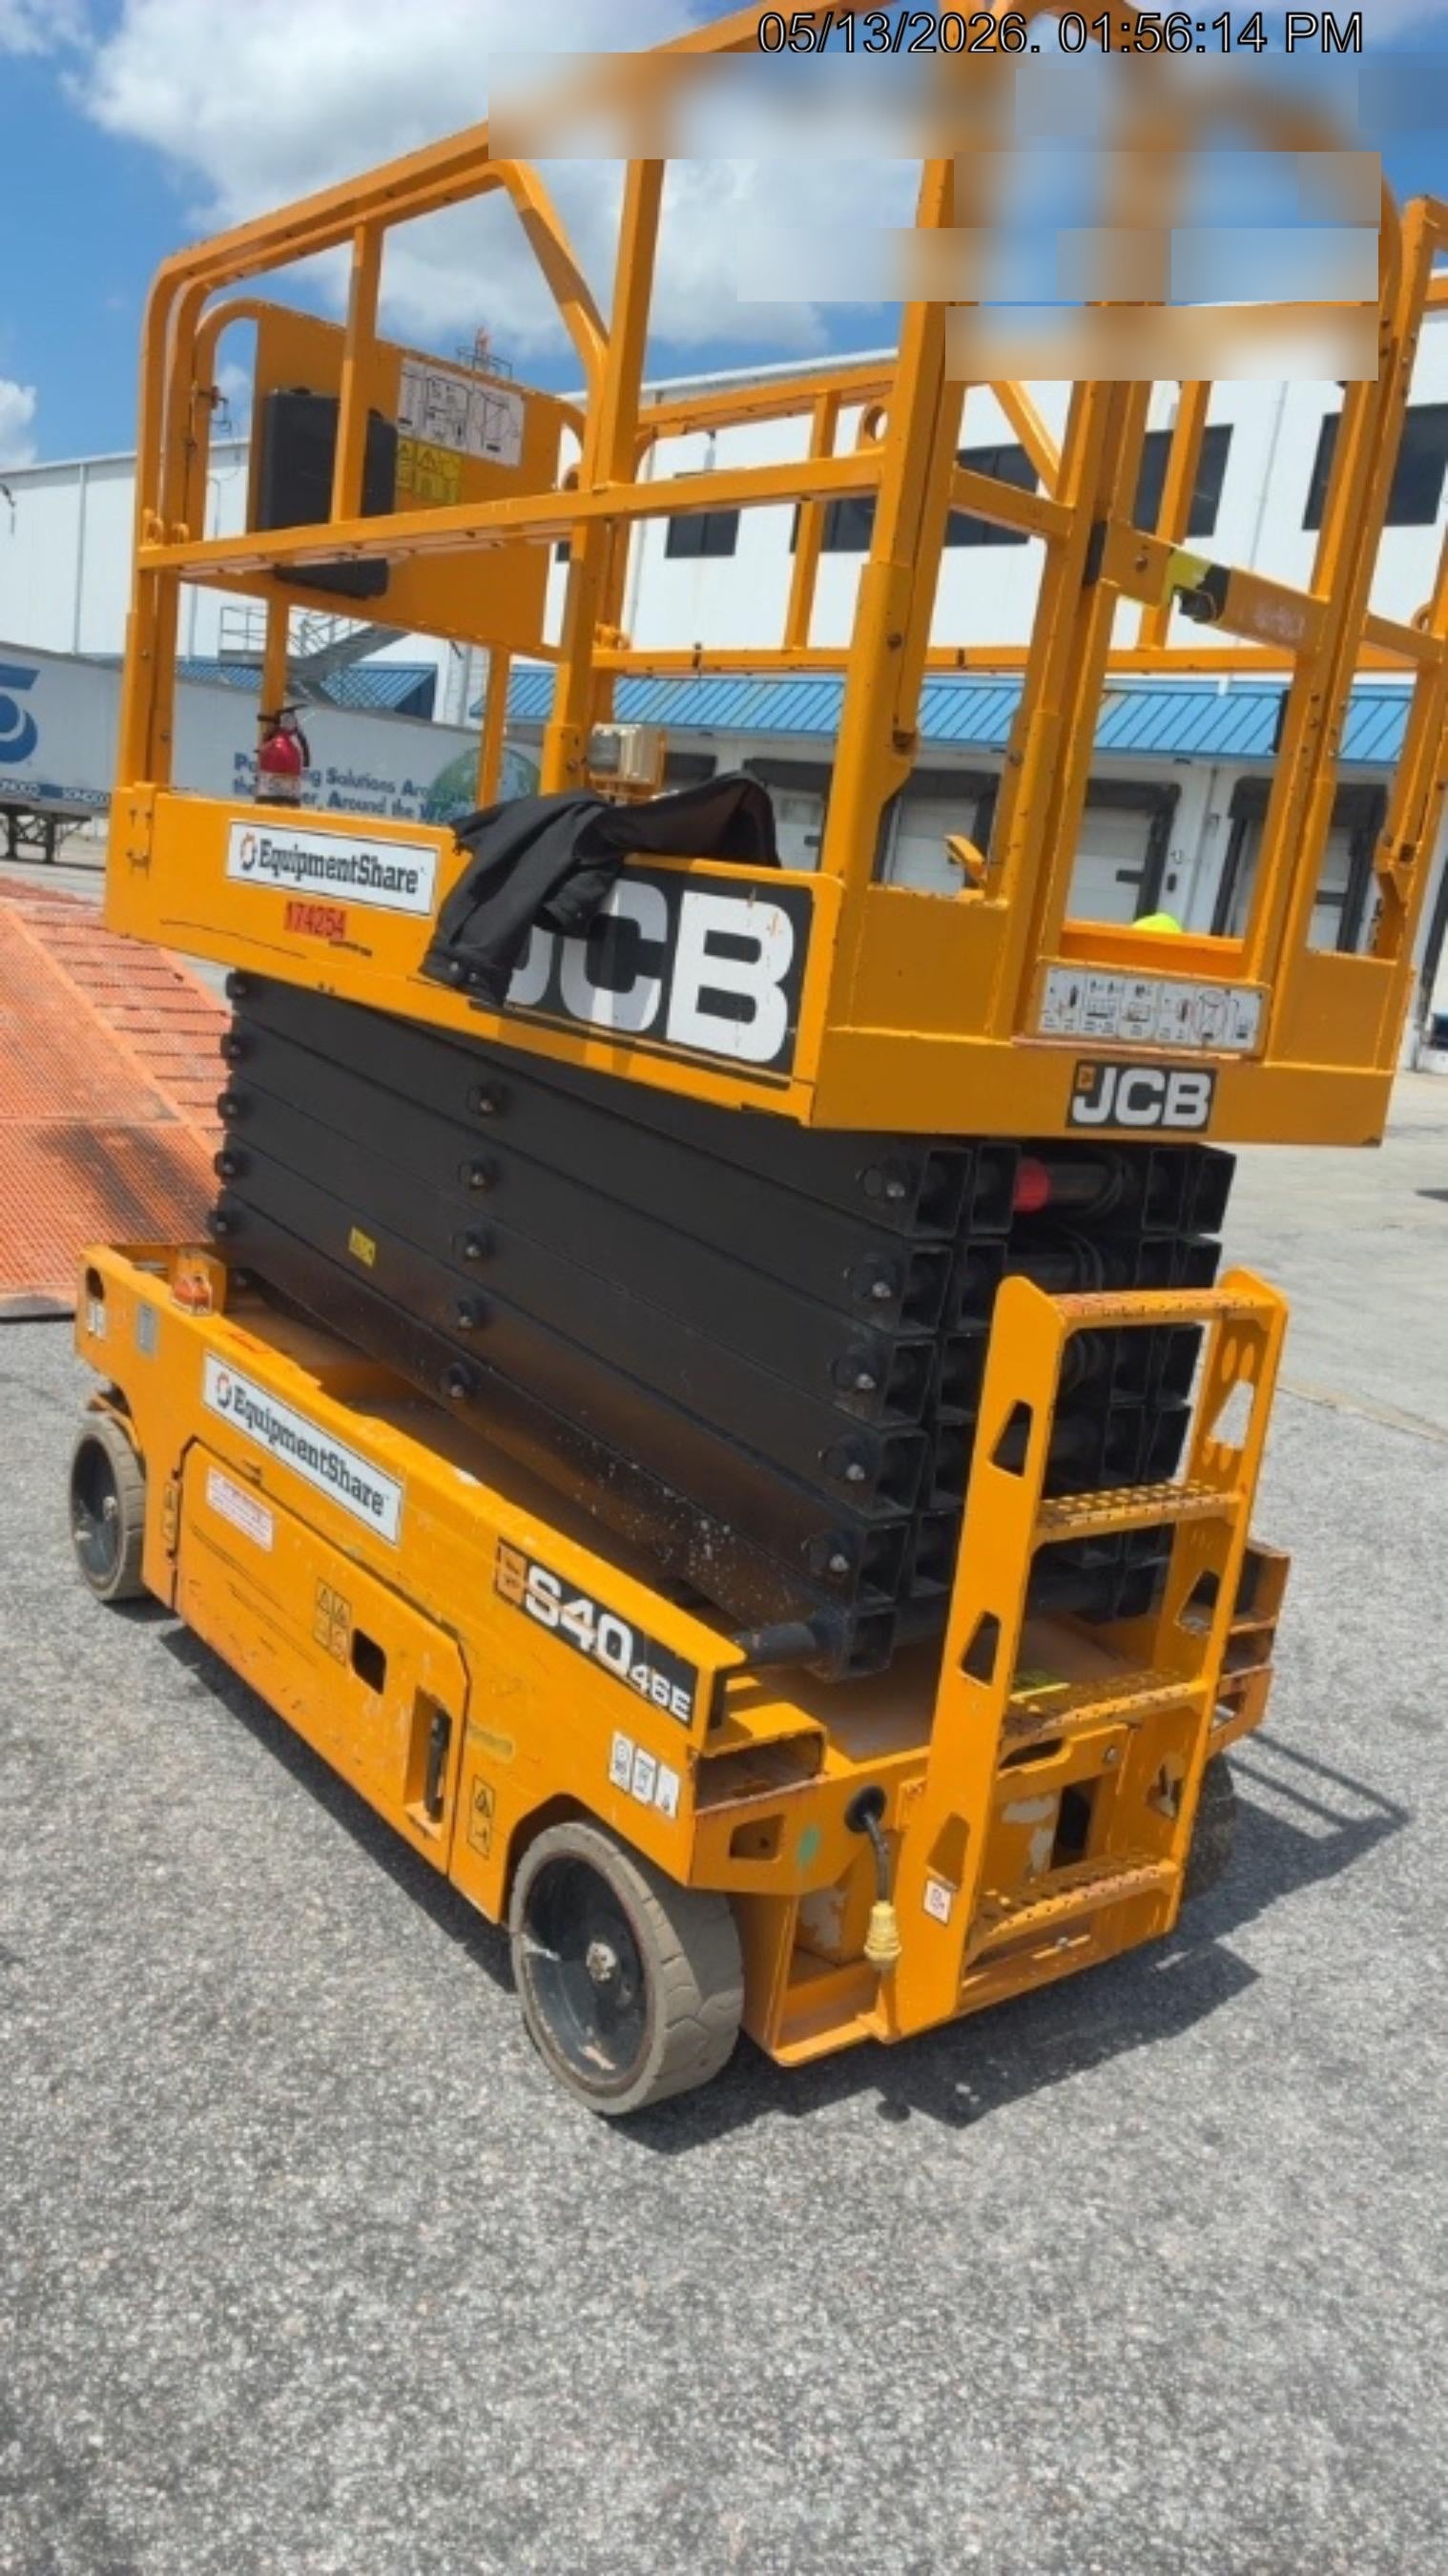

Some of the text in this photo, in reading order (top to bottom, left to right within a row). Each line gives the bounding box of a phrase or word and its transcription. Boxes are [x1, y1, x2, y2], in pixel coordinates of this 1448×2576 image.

[326, 766, 396, 796] Solutions
[327, 789, 386, 816] Around
[392, 798, 414, 819] the
[259, 838, 419, 894] EquipmentShare
[1072, 1066, 1212, 1127] JCB
[234, 1383, 384, 1516] EquipmentShare
[526, 1564, 634, 1677] S40
